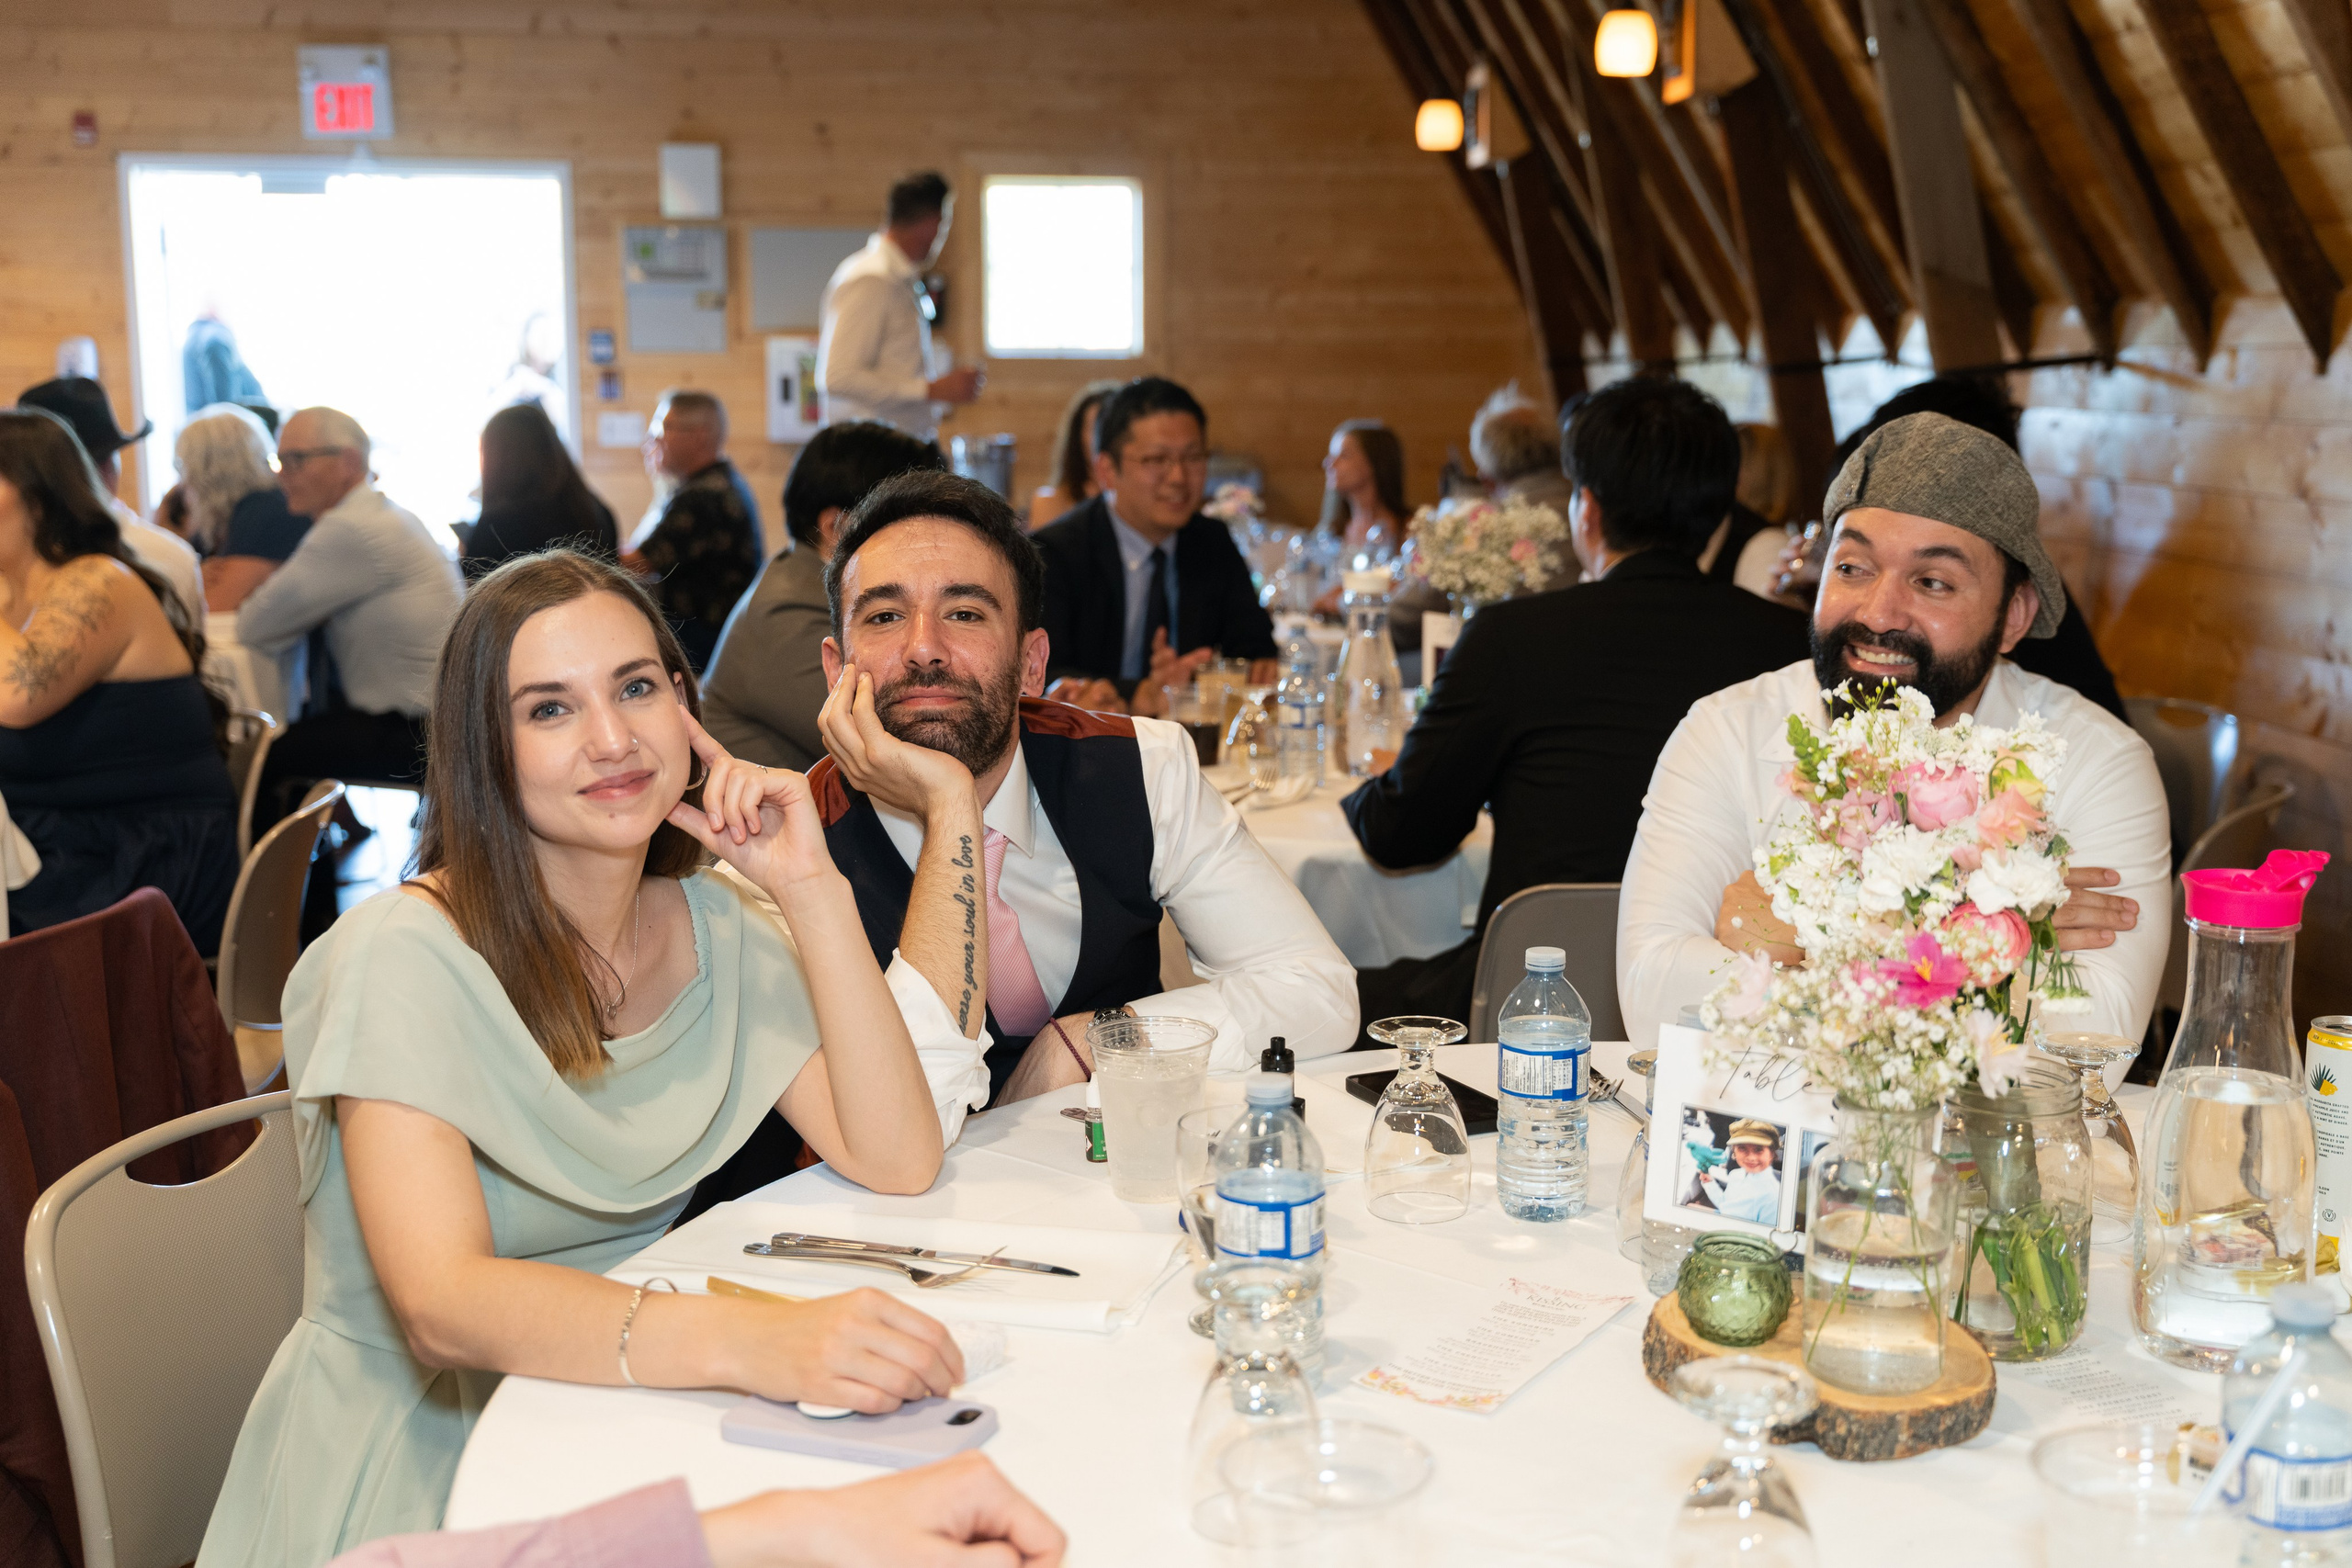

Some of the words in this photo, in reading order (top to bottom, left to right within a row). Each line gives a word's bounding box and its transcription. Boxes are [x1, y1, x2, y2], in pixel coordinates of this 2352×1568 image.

[314, 83, 374, 132] EXIT
[952, 835, 973, 869] love
[959, 874, 975, 894] in
[953, 894, 975, 938] soul
[964, 940, 978, 990] your
[1719, 1046, 1837, 1101] Table
[1526, 1294, 1587, 1310] KISSING
